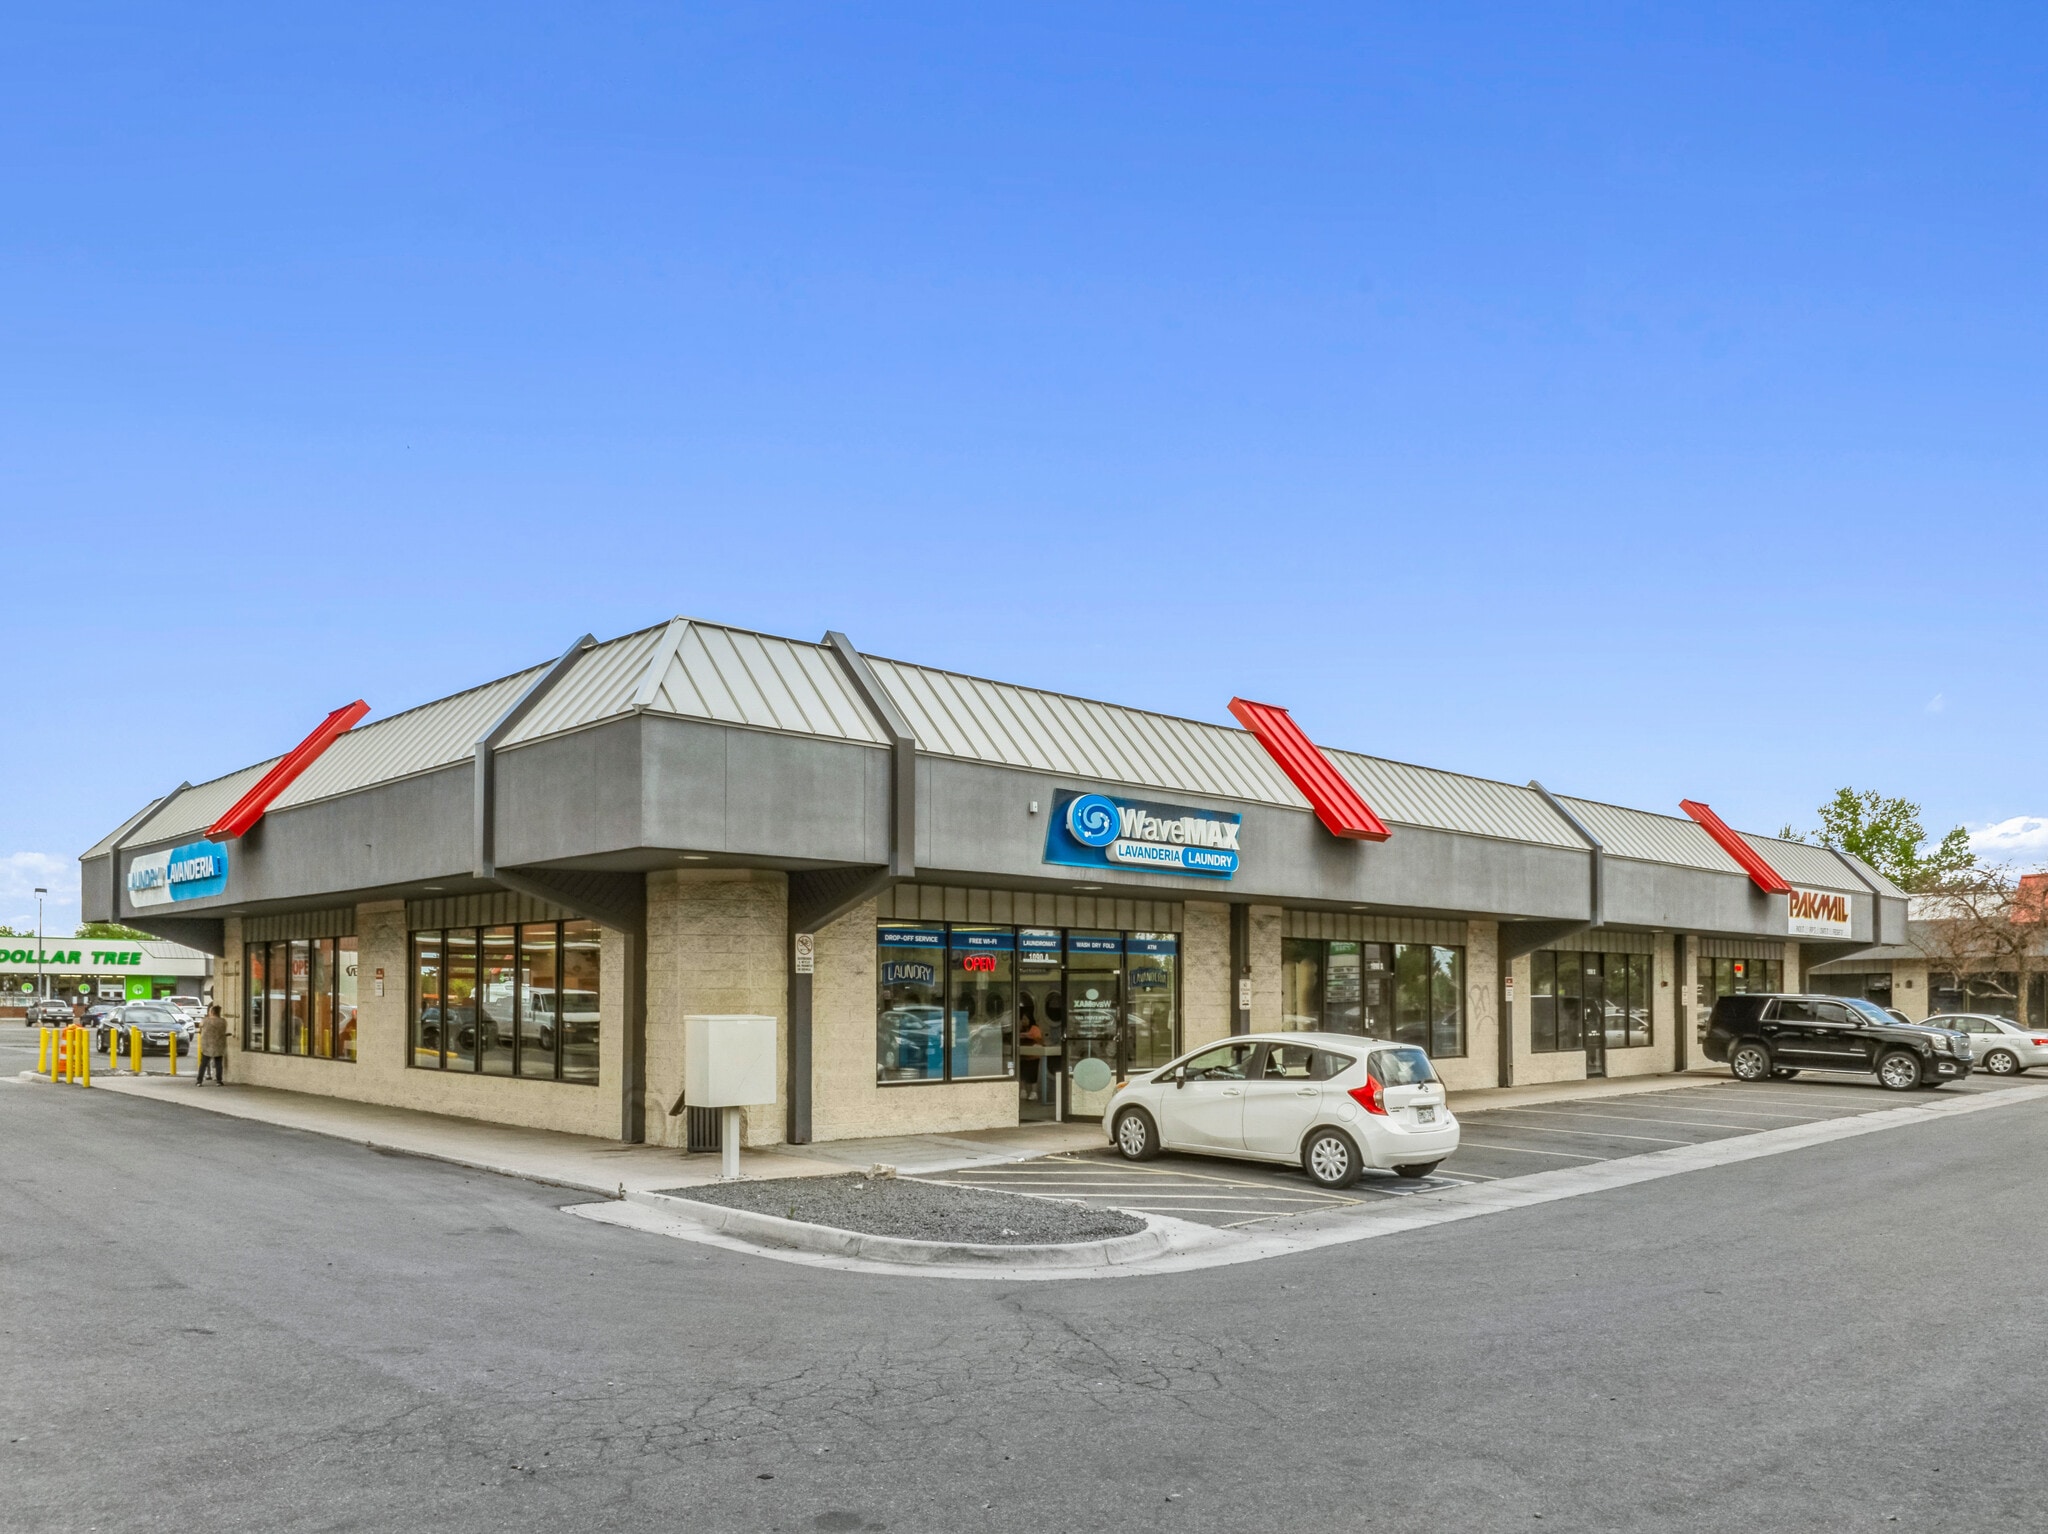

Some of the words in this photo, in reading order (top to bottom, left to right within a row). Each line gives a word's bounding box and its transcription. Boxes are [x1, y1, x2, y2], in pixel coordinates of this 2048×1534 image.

[1116, 807, 1240, 850] WaveMAX
[1118, 844, 1181, 863] LAVANDERIA
[1188, 851, 1233, 867] LAUNDRY
[166, 855, 217, 884] LAVANDERIA
[884, 934, 914, 942] DROP-OFF
[0, 949, 82, 964] DOLLAR
[91, 951, 143, 965] TREE
[963, 955, 997, 972] OPEN
[887, 964, 932, 981] LAUNDRY
